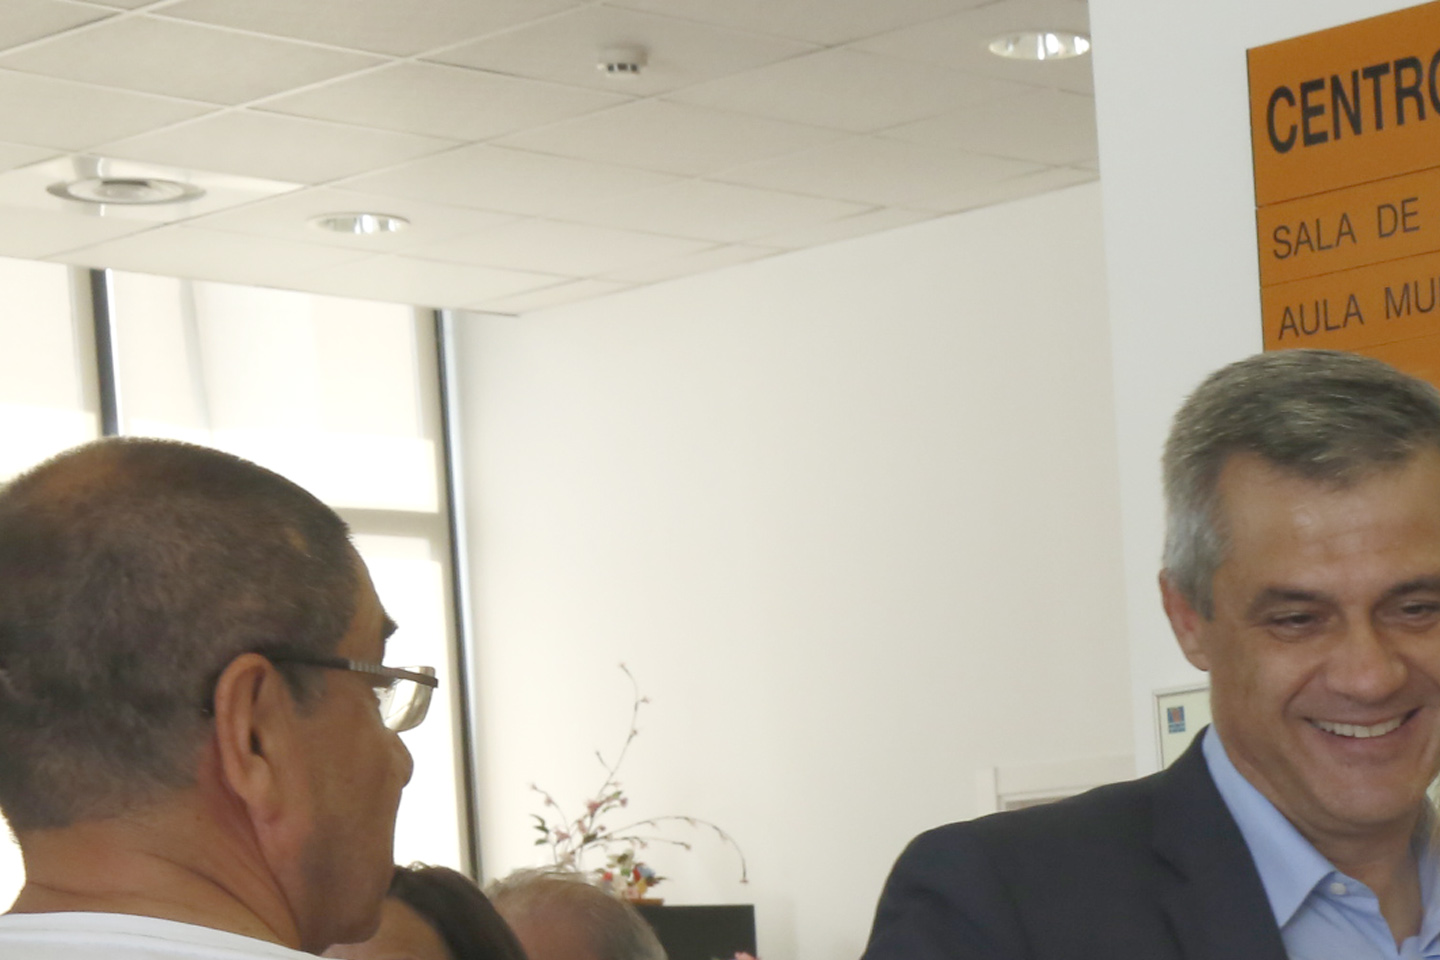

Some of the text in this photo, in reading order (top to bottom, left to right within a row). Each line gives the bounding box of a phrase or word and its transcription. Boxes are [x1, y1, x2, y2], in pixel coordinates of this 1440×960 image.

[1272, 212, 1357, 260] SALA
[1377, 197, 1420, 238] DE
[1278, 293, 1365, 341] AULA
